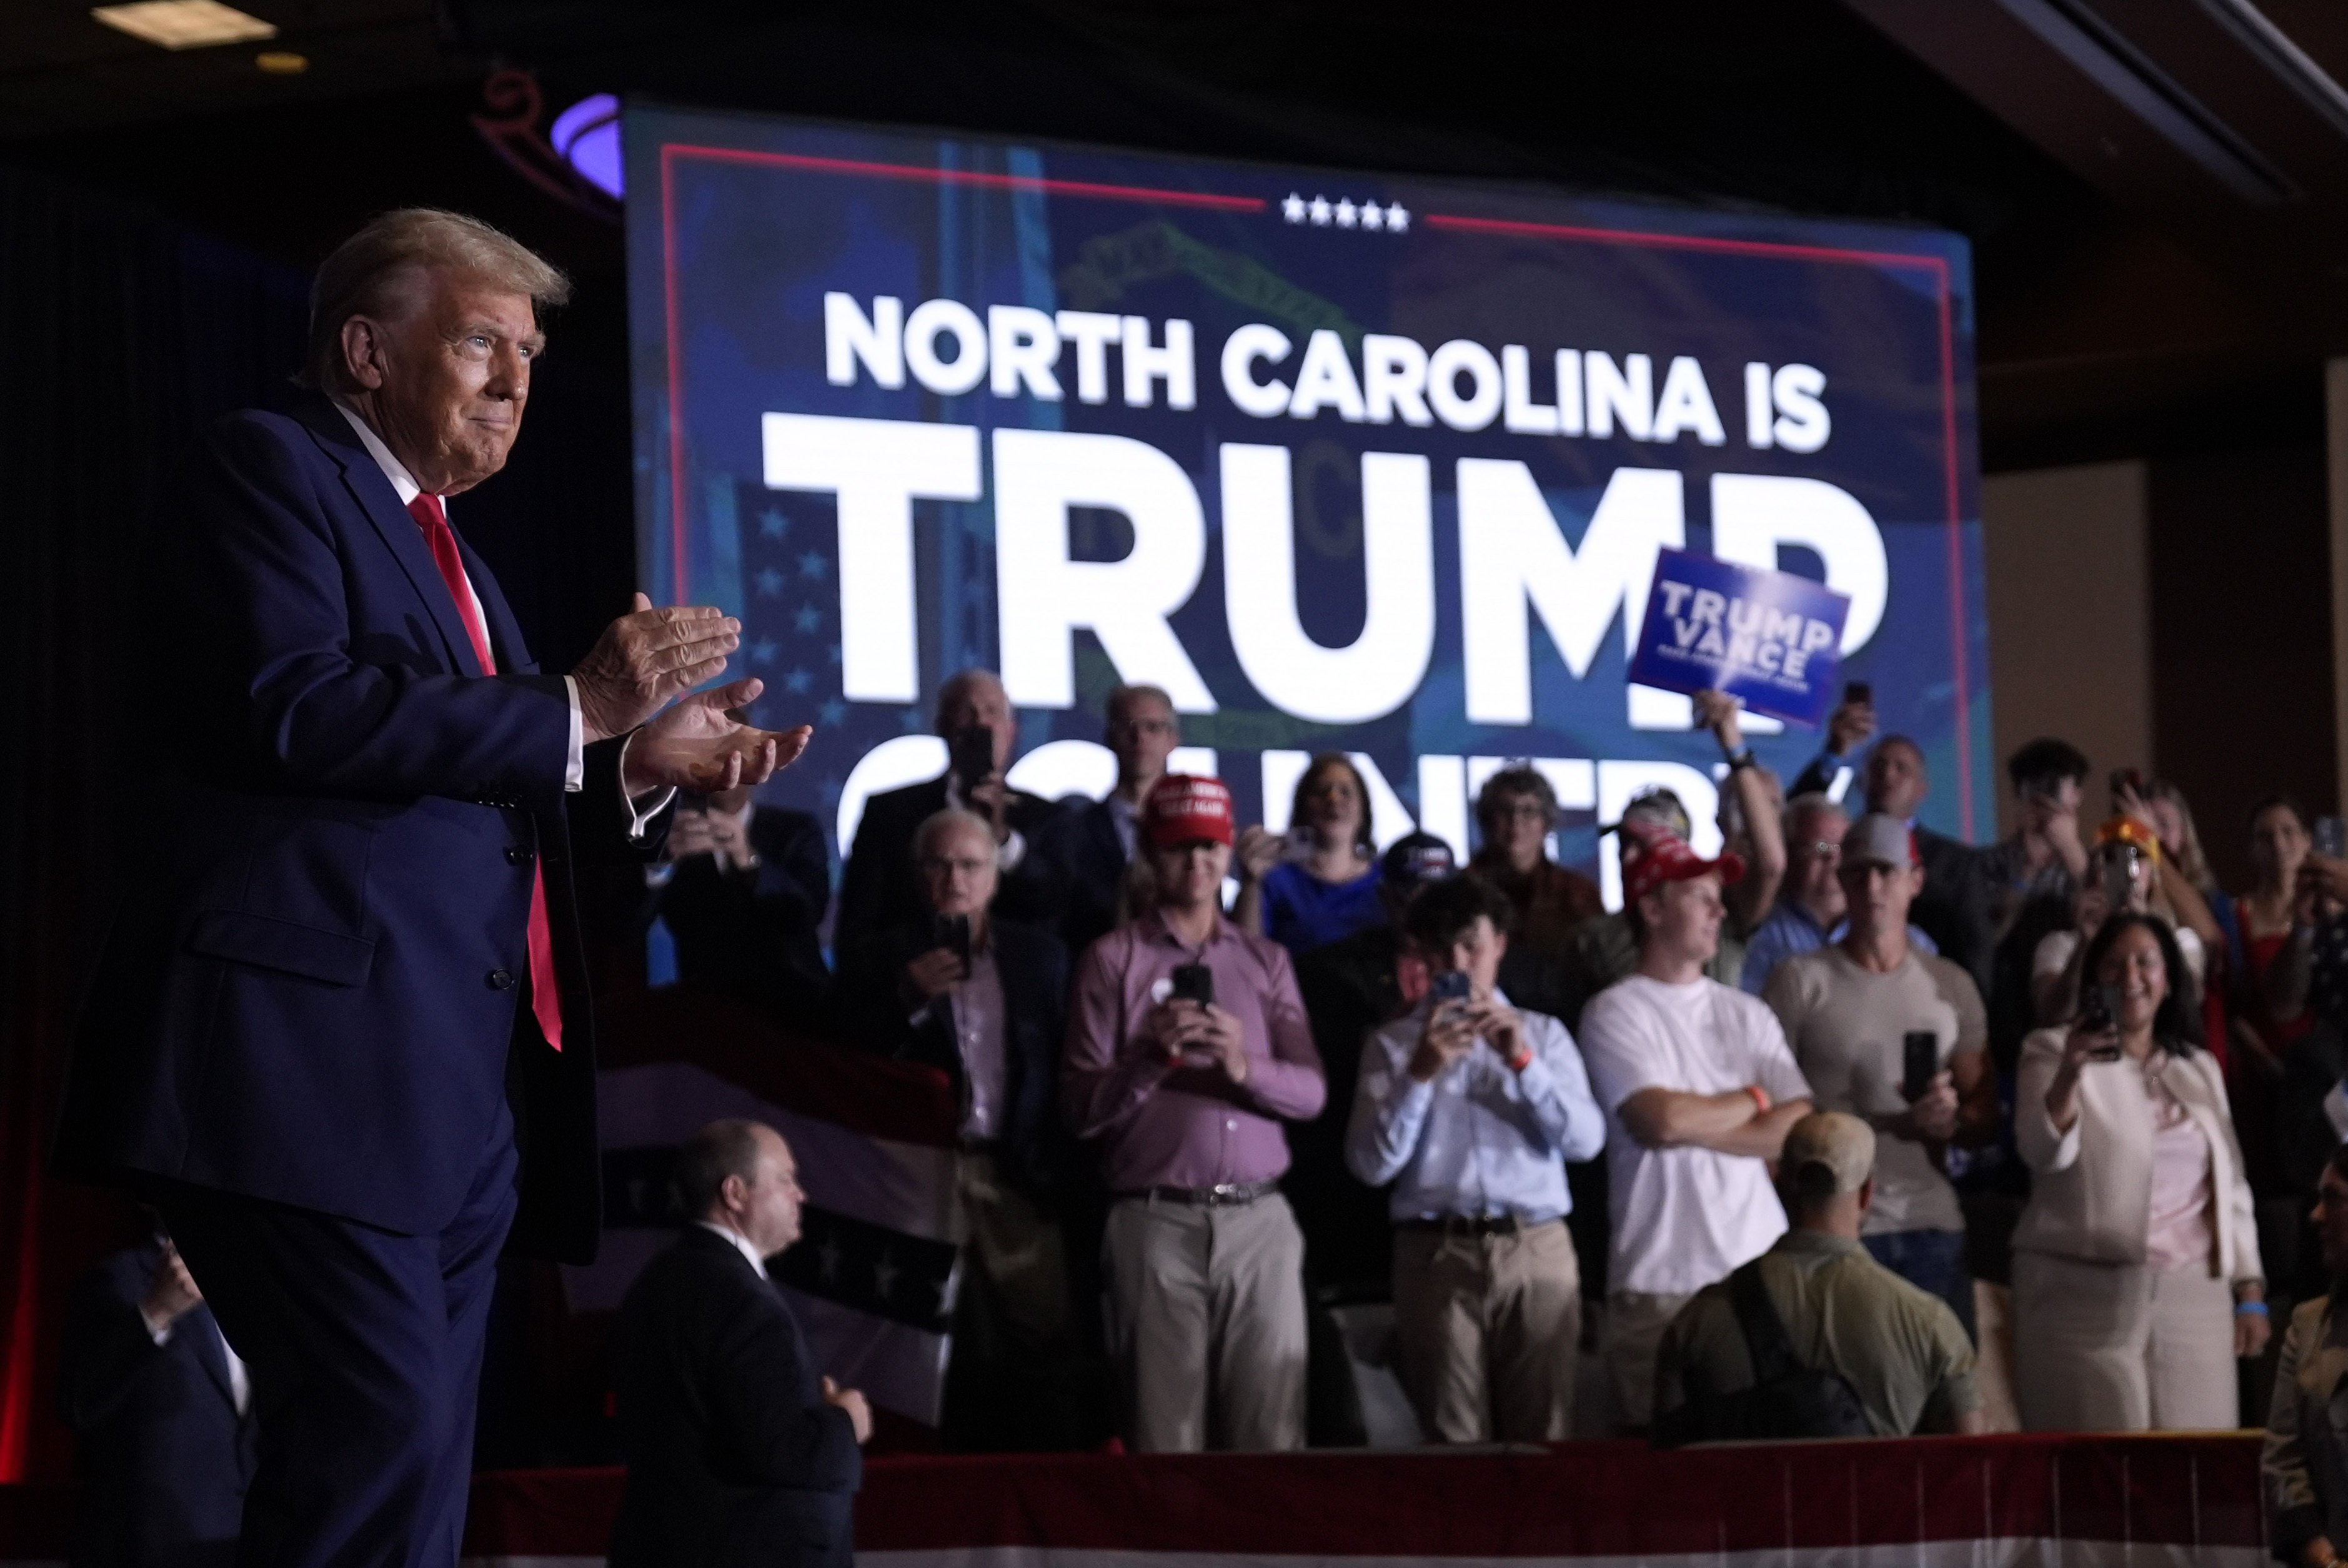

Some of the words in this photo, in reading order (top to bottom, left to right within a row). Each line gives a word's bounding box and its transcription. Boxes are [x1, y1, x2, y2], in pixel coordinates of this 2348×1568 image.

[824, 291, 1196, 410] NORTH
[1221, 324, 1726, 445] CAROLINA
[1744, 362, 1831, 452] IS
[760, 412, 1889, 734] TRUMP
[1660, 579, 1834, 652] TRUMP
[1673, 616, 1809, 678] VANCE
